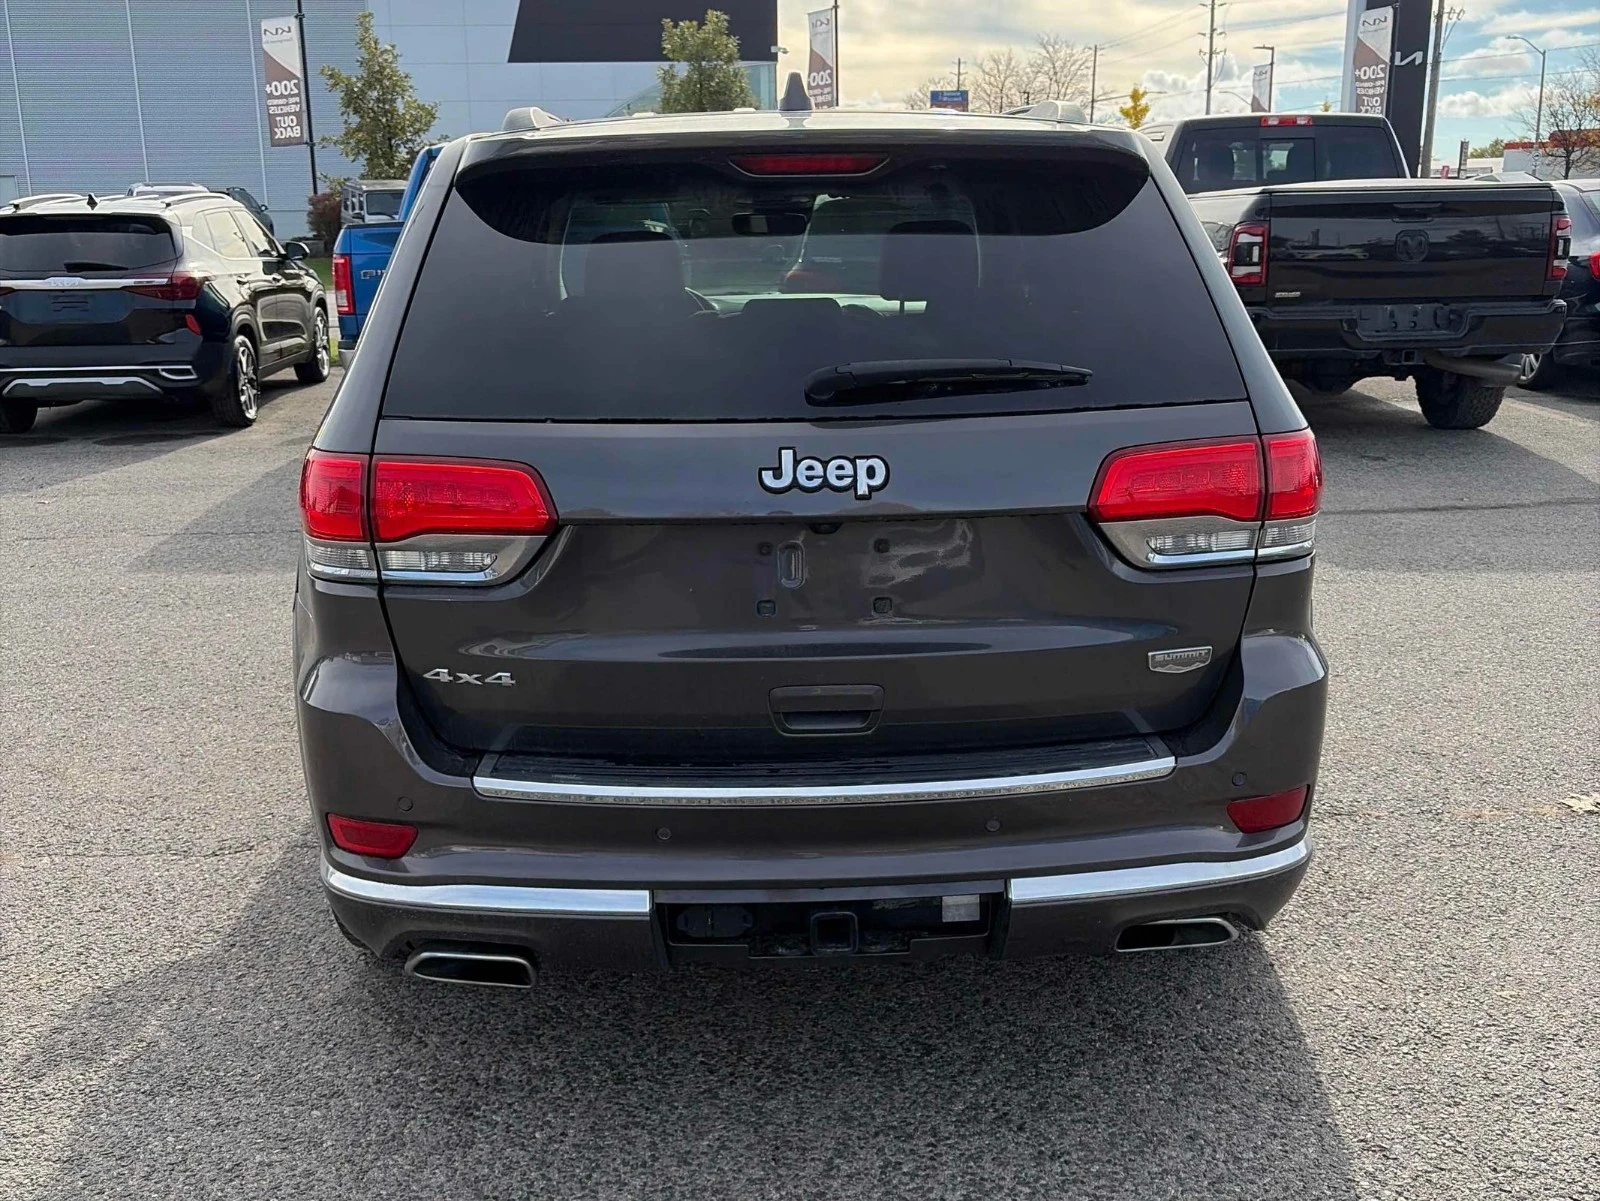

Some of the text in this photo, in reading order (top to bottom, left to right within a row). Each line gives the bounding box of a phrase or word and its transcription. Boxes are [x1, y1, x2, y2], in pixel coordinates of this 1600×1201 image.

[760, 448, 888, 499] Jeep
[1155, 649, 1209, 661] SUMMIT
[422, 668, 516, 686] 4x4
